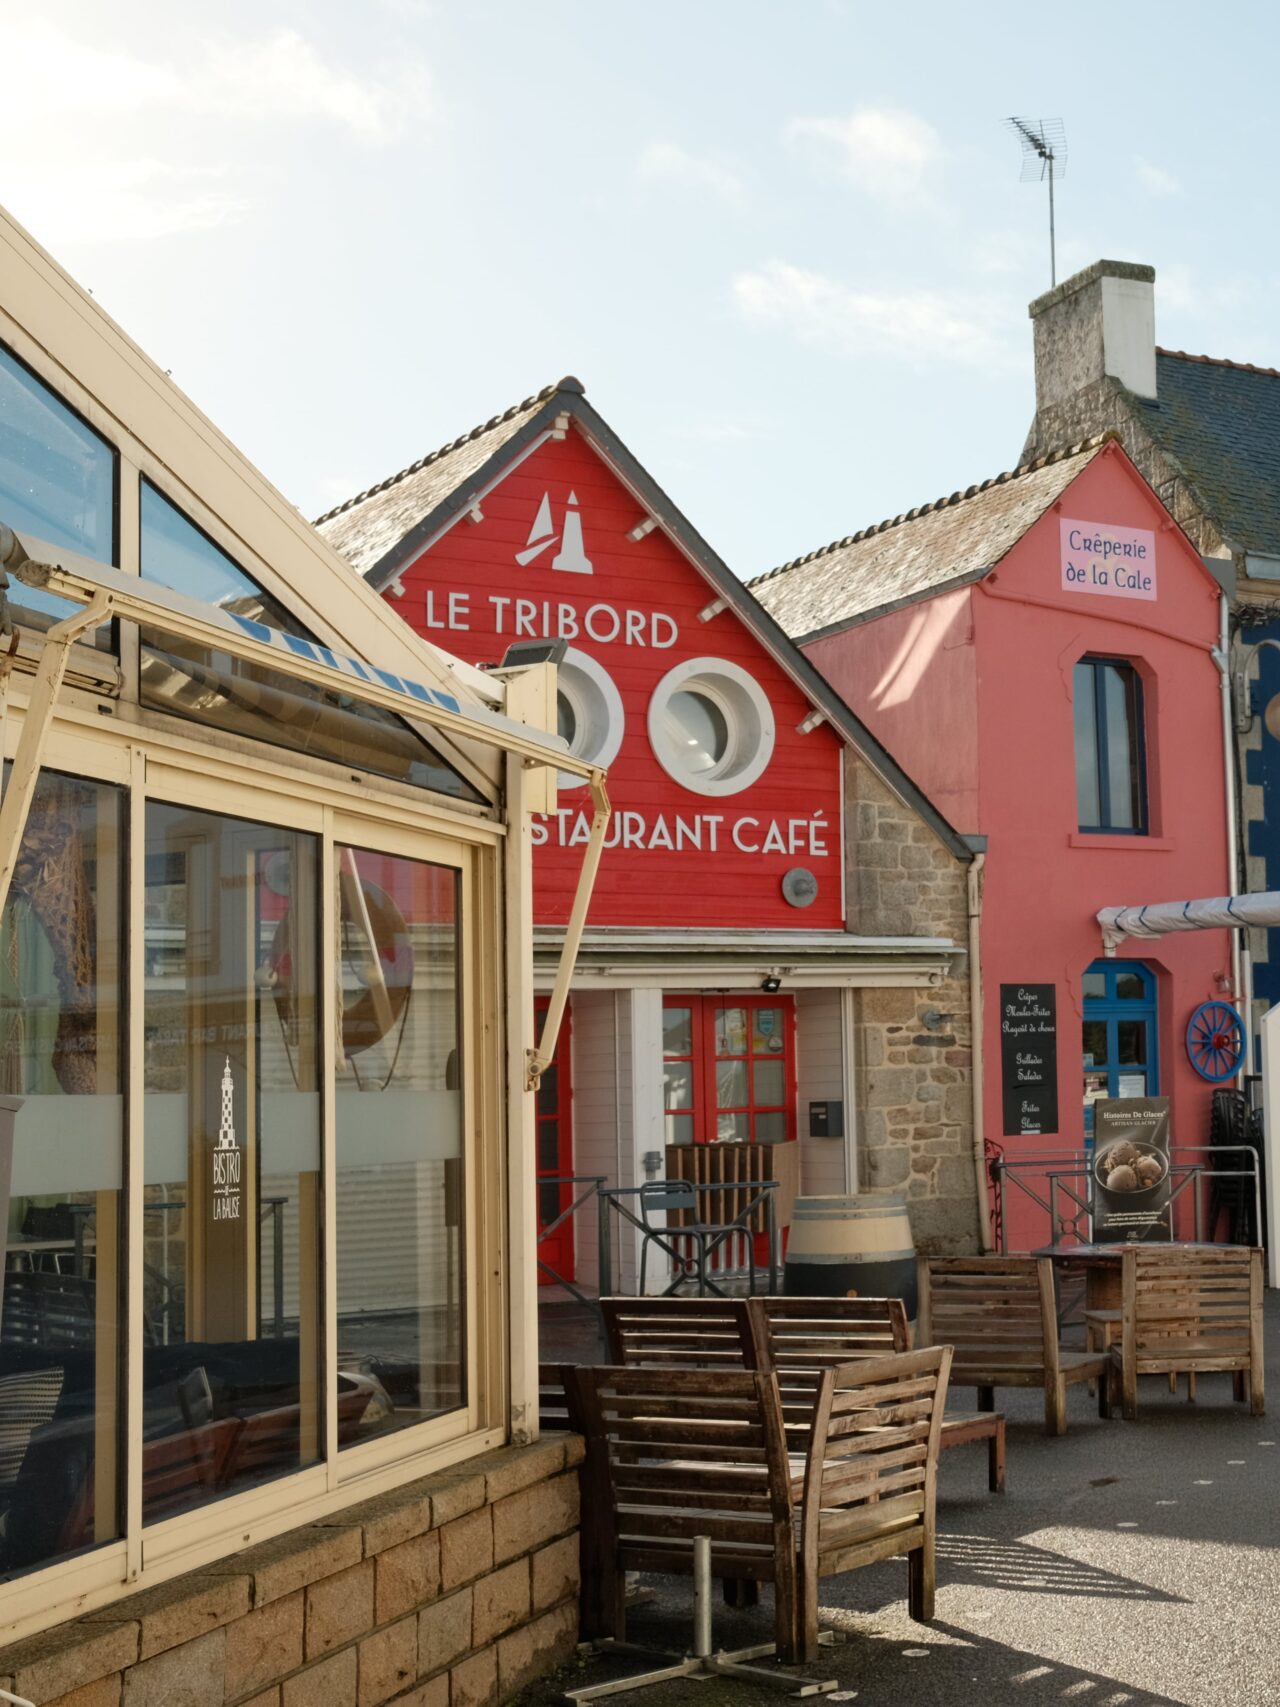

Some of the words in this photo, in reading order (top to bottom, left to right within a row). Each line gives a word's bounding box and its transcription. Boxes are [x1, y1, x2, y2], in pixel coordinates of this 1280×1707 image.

[1069, 530, 1146, 560] Crêperie
[1066, 561, 1086, 583] de
[1092, 564, 1108, 586] la
[1114, 567, 1152, 591] Cale
[426, 590, 470, 631] LE
[488, 595, 679, 649] TRIBORD
[732, 809, 829, 857] CAFÉ
[1005, 1004, 1051, 1017] Moules-Frites
[1017, 1068, 1042, 1081] Salades
[1021, 1100, 1040, 1113] Frites
[1021, 1117, 1041, 1129] Glaces
[213, 1151, 240, 1185] BISTRO
[213, 1197, 221, 1221] LA
